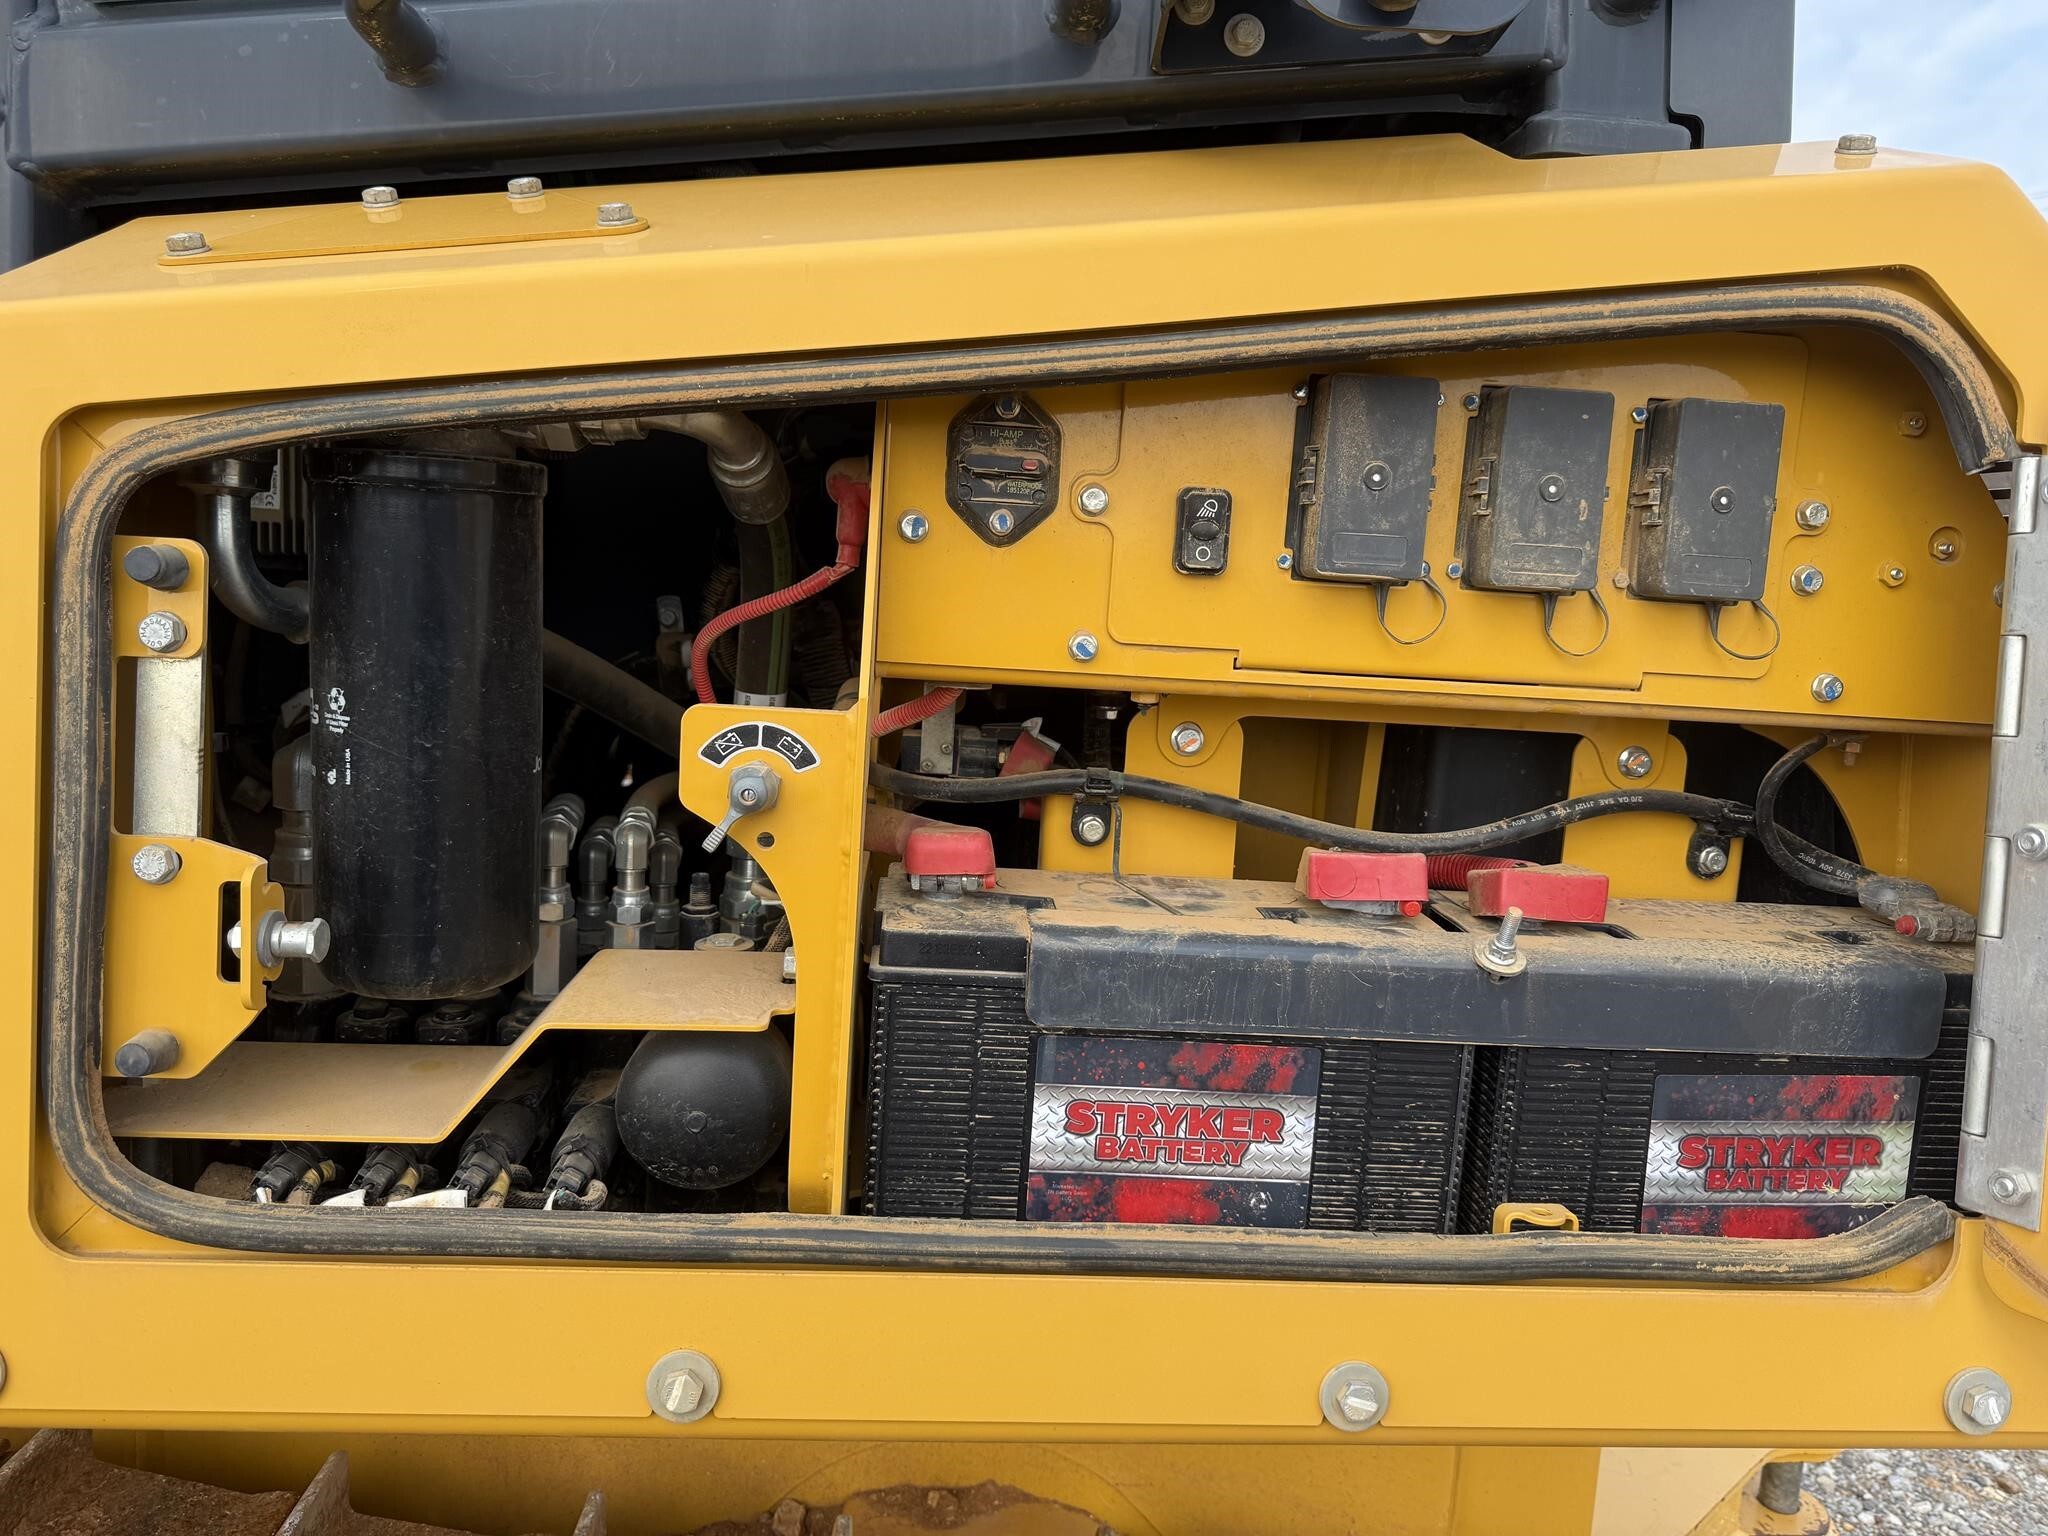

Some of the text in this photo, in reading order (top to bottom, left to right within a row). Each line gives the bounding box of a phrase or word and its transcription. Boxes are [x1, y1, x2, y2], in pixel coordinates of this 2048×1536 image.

[990, 428, 1024, 439] HI-AMP
[1065, 1100, 1285, 1143] STRYKER
[1095, 1135, 1249, 1166] BATTERY
[1677, 1135, 1883, 1168] STRYKER
[1705, 1167, 1850, 1193] BATTERY
